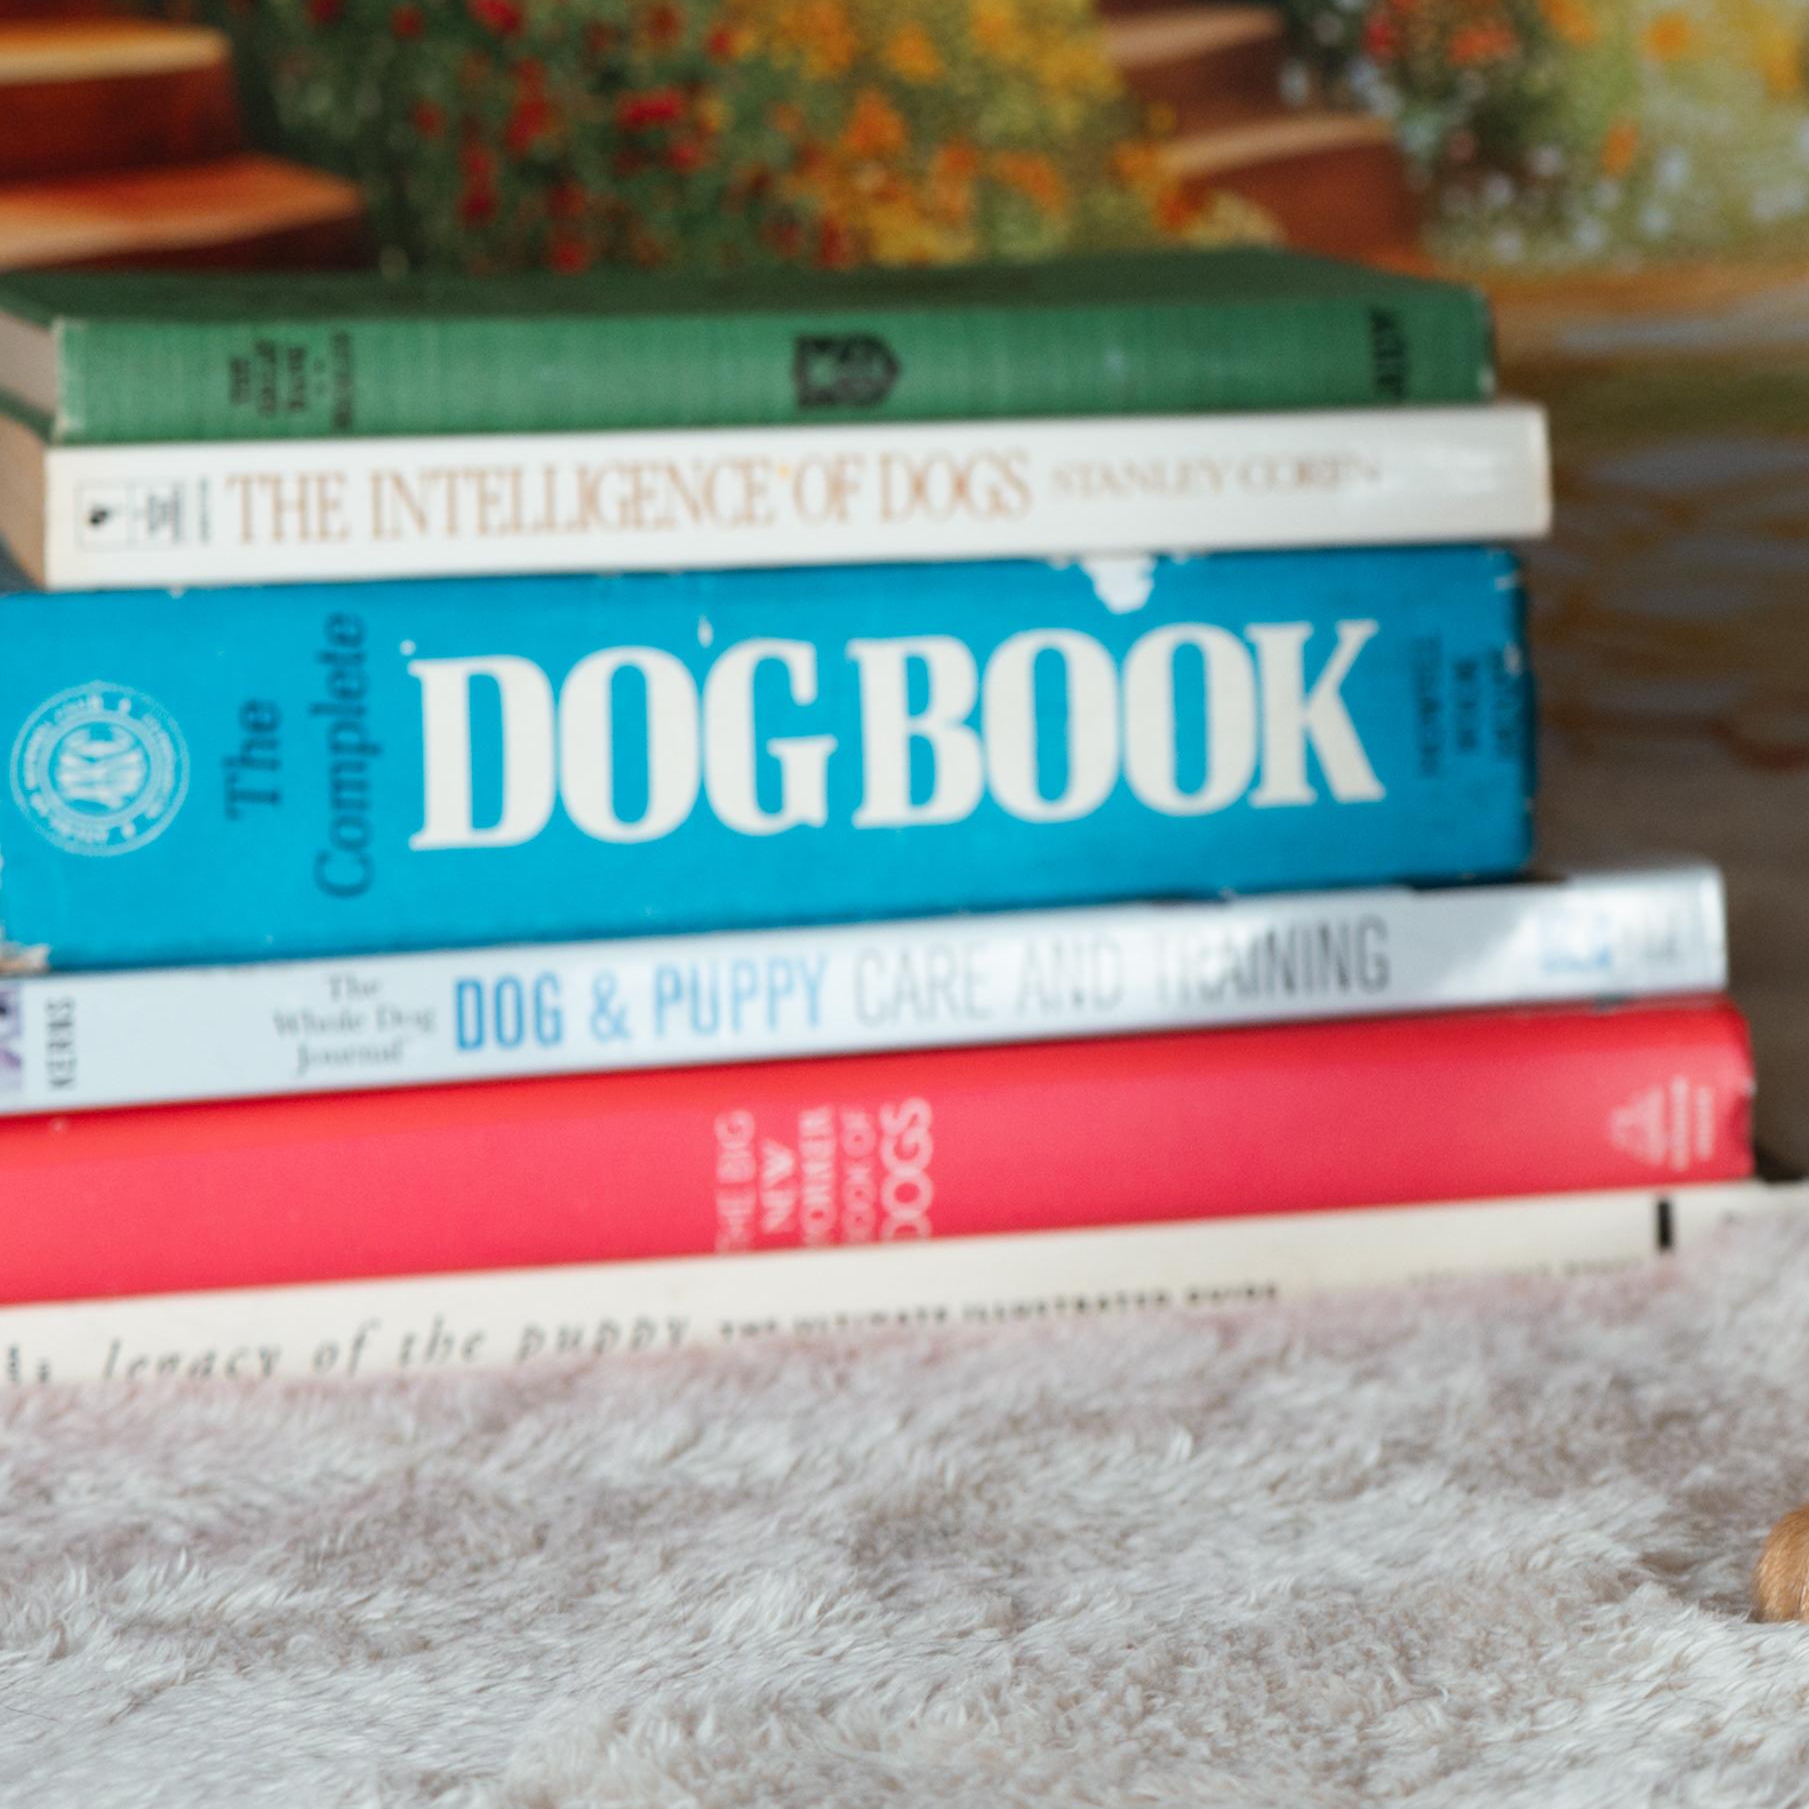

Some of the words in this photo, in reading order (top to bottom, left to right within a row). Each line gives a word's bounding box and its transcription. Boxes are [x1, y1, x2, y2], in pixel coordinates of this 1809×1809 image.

[227, 472, 351, 544] THE
[370, 455, 780, 540] INTELLIGENCE
[793, 452, 868, 526] OF
[879, 449, 1031, 523] DOGS
[1050, 458, 1230, 500] STANLEY
[223, 698, 283, 822] The
[308, 611, 384, 900] Complete
[408, 636, 838, 852] DOG
[847, 618, 1386, 830] BOOK
[455, 971, 565, 1052] DOG
[590, 966, 632, 1041] &
[655, 952, 831, 1038] PUPPY
[854, 945, 993, 1026] CARE
[1016, 935, 1127, 1016] AND
[312, 1320, 378, 1377] of
